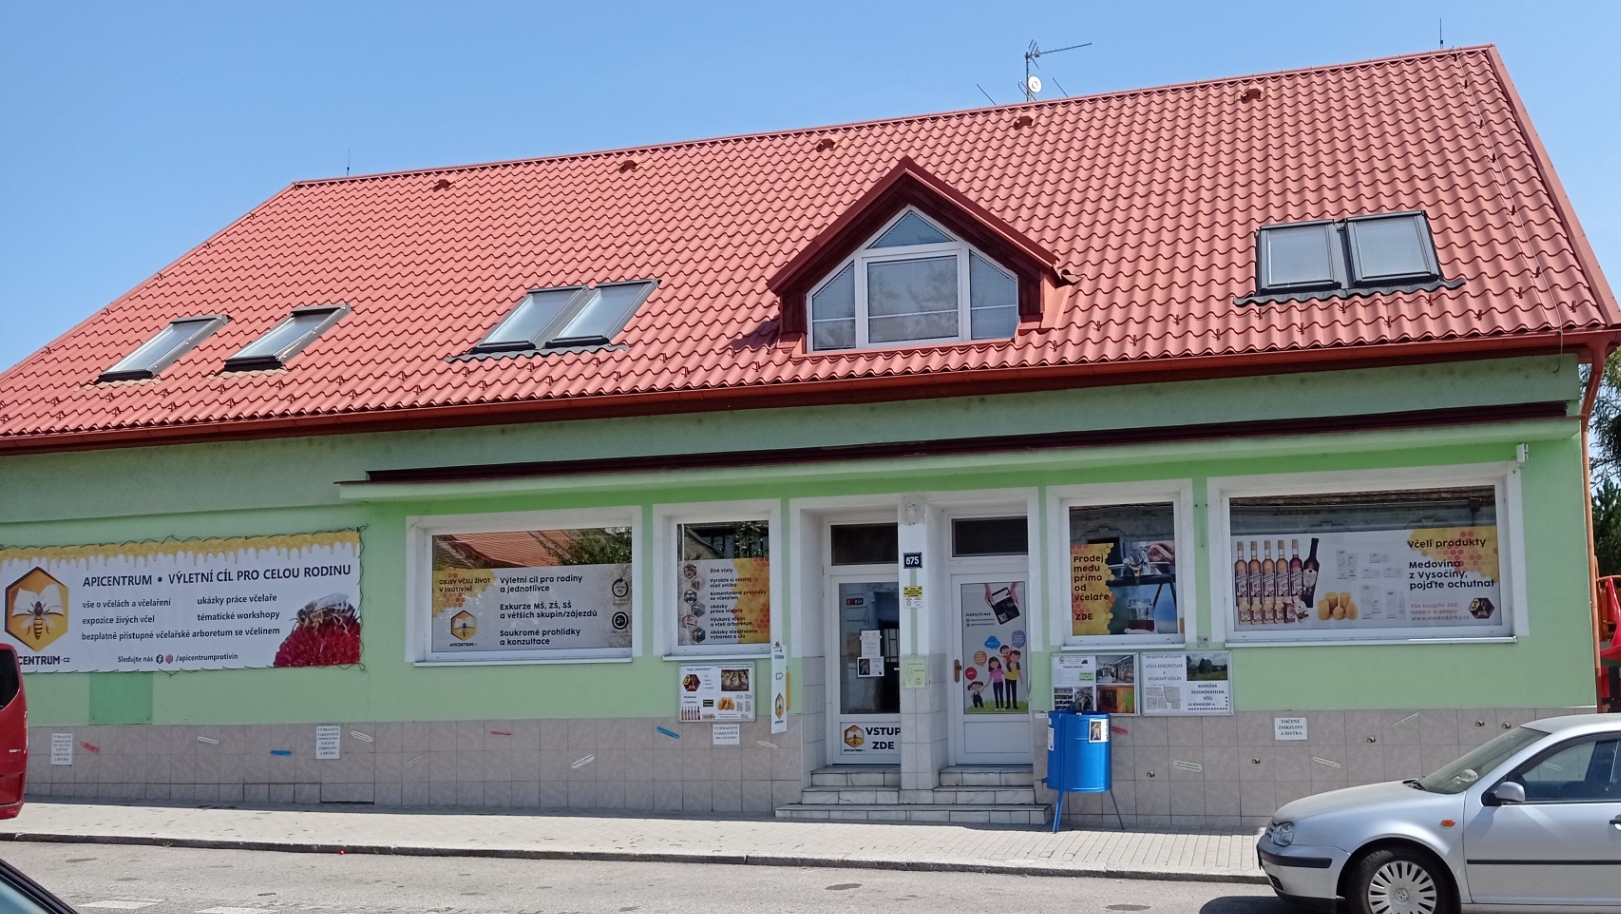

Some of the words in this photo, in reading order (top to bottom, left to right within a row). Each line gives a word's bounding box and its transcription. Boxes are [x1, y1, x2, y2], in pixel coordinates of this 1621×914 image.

[1408, 540, 1432, 549] Včelí
[1436, 538, 1486, 549] produkty
[1073, 554, 1104, 564] Prodej
[1073, 564, 1100, 572] medu
[1409, 560, 1461, 569] Medovina
[82, 575, 152, 587] APICENTRUM
[168, 569, 214, 584] VÝLETNÍ
[216, 568, 234, 582] CÍL
[237, 570, 260, 581] PRO
[263, 568, 300, 580] CELOU
[304, 564, 351, 578] RODINU
[500, 576, 526, 586] Výletní
[556, 574, 583, 583] rodiny
[1074, 574, 1102, 583] přímo
[1418, 570, 1468, 581] Vysočiny,
[507, 584, 550, 594] jednotlivce
[1074, 584, 1086, 592] od
[1410, 580, 1444, 591] pojďte
[1448, 579, 1495, 589] ochutnat
[197, 596, 224, 606] ukázky
[226, 595, 247, 605] práce
[249, 593, 277, 603] včelaře
[1074, 592, 1110, 601] včelaře
[82, 600, 94, 608] vše
[102, 600, 130, 608] včelách
[138, 598, 171, 608] včelaření
[534, 601, 546, 611] MŠ,
[548, 600, 560, 610] ZŠ,
[562, 600, 572, 609] SŠ
[197, 612, 235, 622] tématické
[237, 611, 280, 622] workshopy
[507, 610, 534, 619] větších
[536, 609, 598, 619] skupin/zájezdů
[82, 616, 114, 626] expozice
[116, 616, 138, 626] živých
[140, 614, 155, 623] včel
[82, 632, 117, 642] bezplatně
[156, 630, 190, 638] včelařské
[192, 629, 232, 638] arboretum
[245, 627, 280, 636] včelínem
[500, 628, 540, 637] Soukromé
[542, 628, 580, 637] prohlídky
[507, 638, 550, 646] konzultace
[118, 656, 142, 664] Sledujte
[865, 727, 901, 736] VSTUP
[872, 741, 895, 750] ZDE
